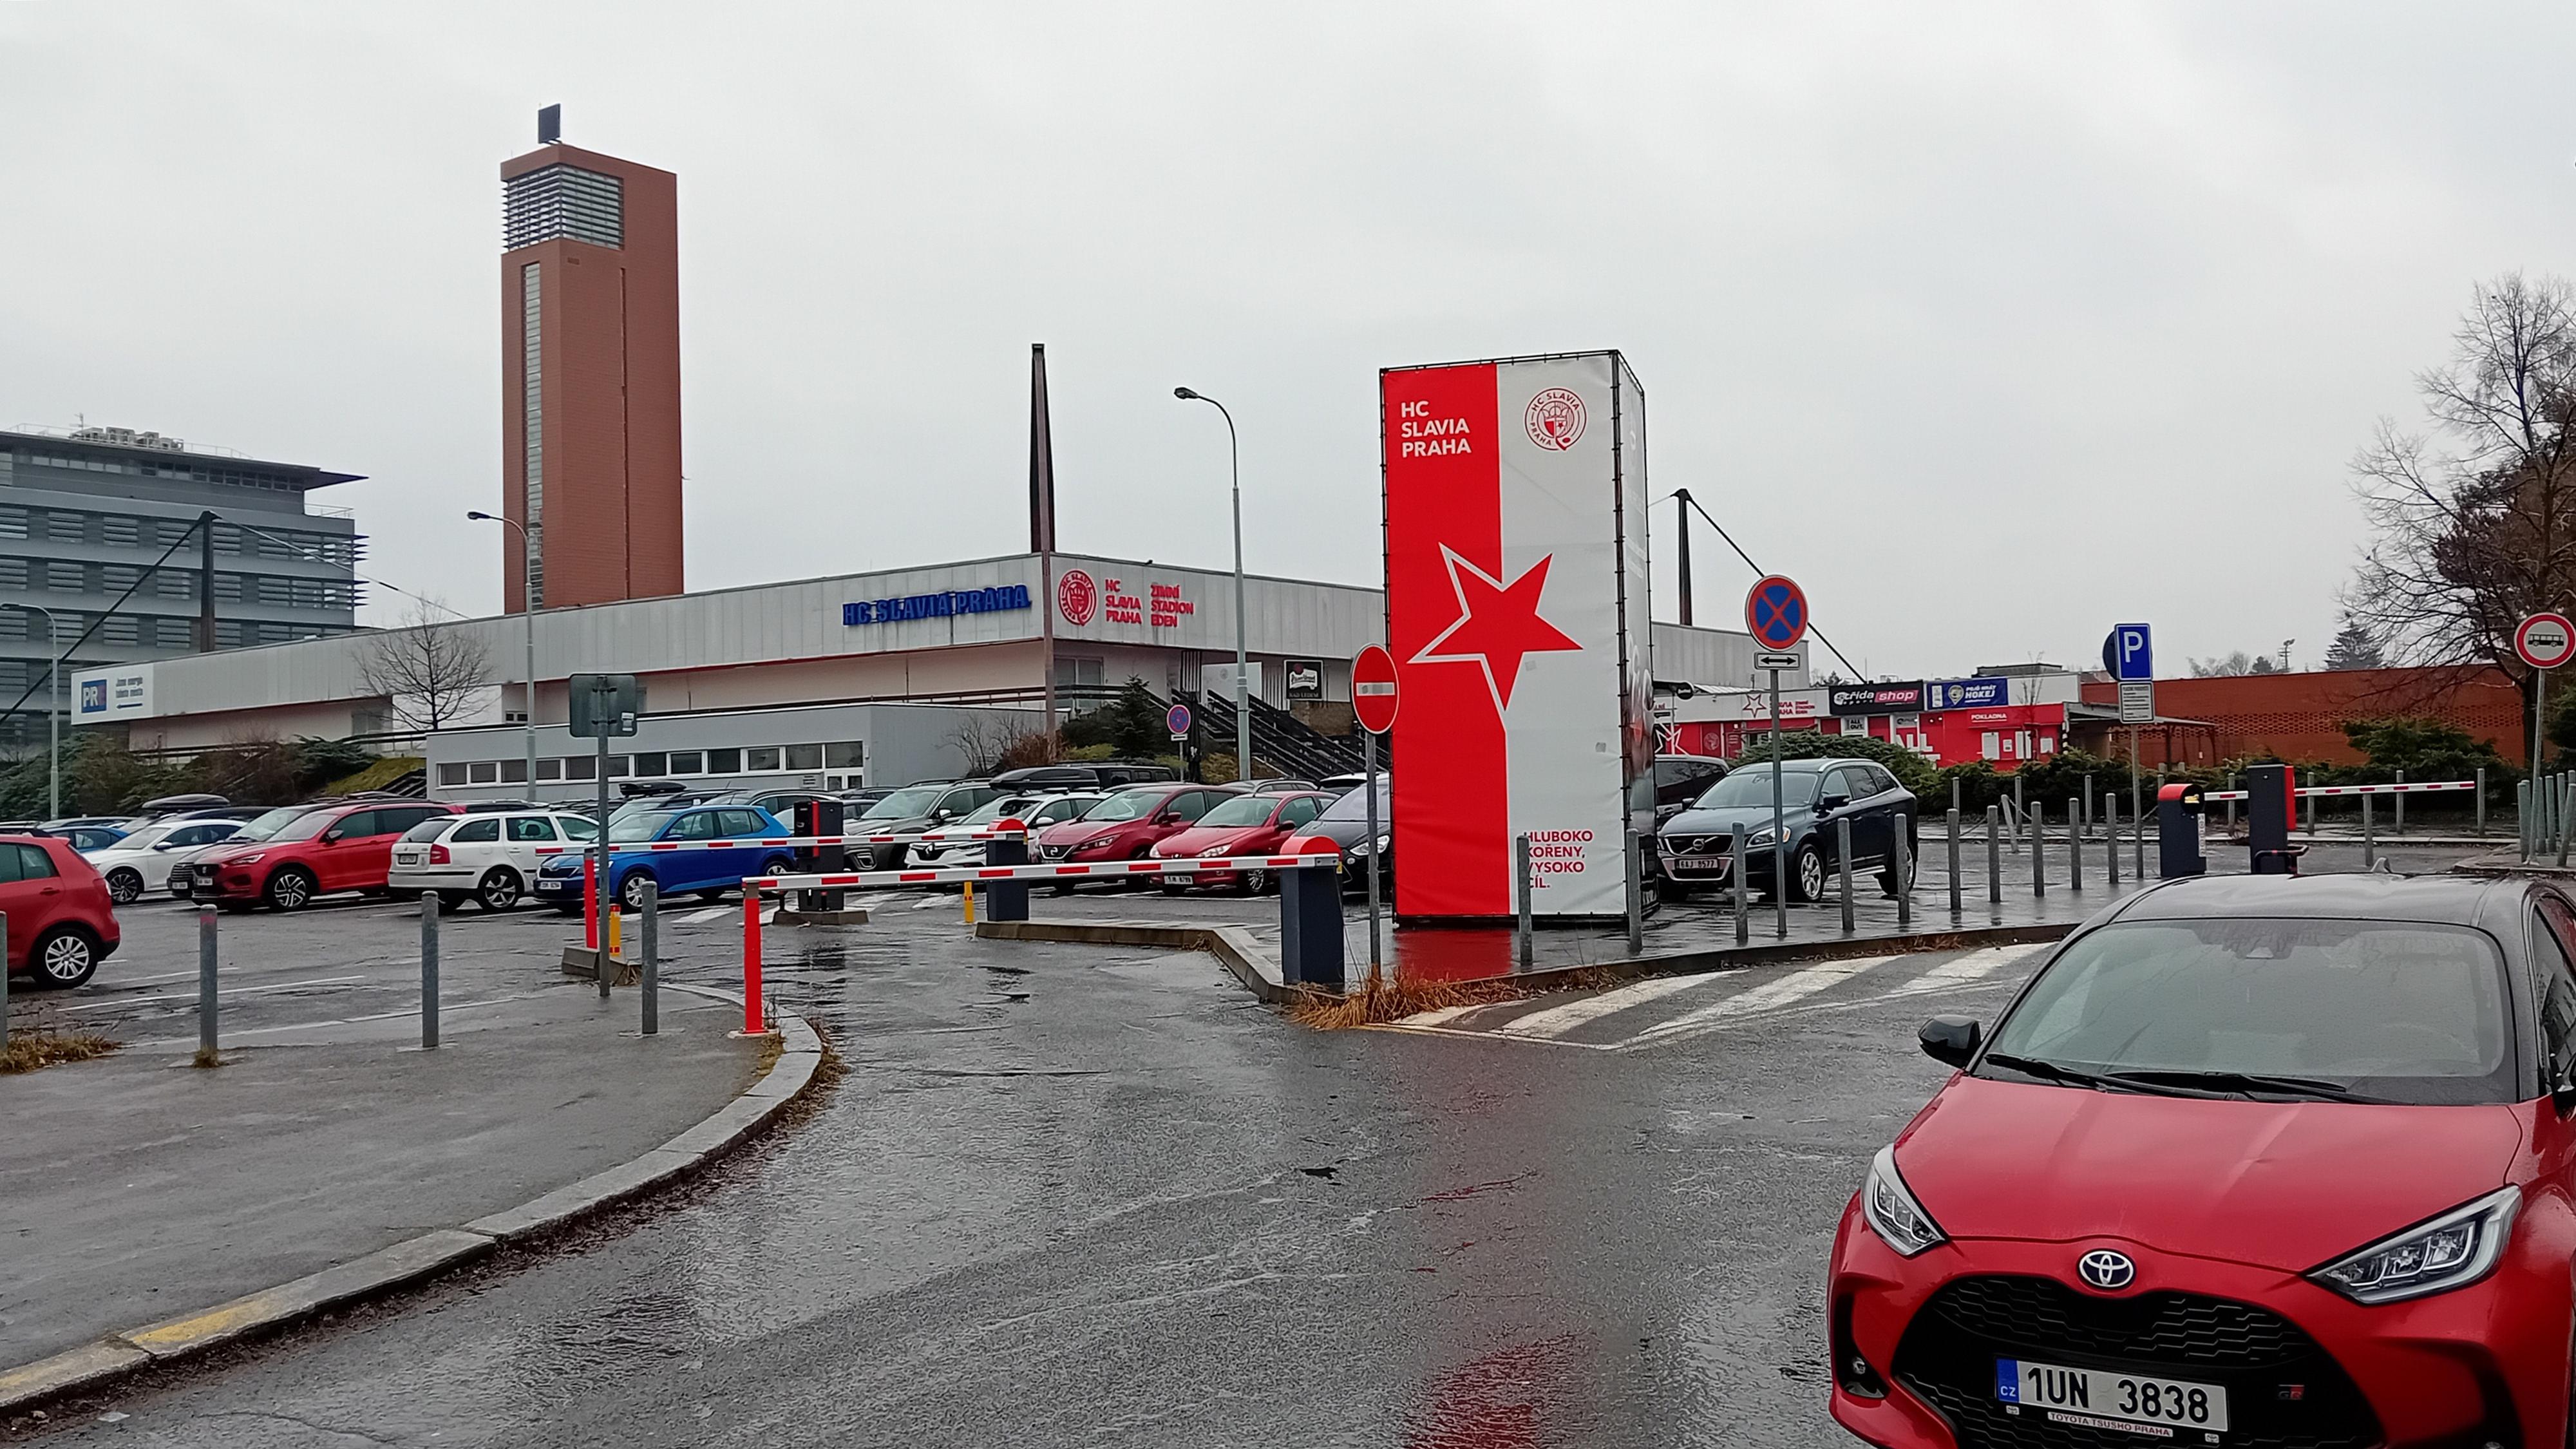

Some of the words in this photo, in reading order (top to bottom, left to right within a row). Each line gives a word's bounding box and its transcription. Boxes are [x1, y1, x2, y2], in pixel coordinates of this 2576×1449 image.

[1401, 401, 1430, 418] HC
[1531, 397, 1544, 412] HC
[1546, 392, 1580, 411] SLAVIA
[1401, 418, 1470, 438] SLAVIA
[1530, 422, 1551, 446] PRAHA
[1402, 438, 1472, 458] PRAHA
[1105, 579, 1121, 592] HC
[1151, 583, 1180, 599] ZIMNÍ
[843, 602, 871, 625] HC
[874, 591, 952, 623] SLAVIA
[954, 584, 1030, 615] PRAHA
[1106, 595, 1141, 610] SLAVIA
[1151, 600, 1194, 615] STADION
[1106, 610, 1142, 625] PRAHA
[1151, 614, 1178, 628] EDEN
[2123, 631, 2143, 663] P
[1879, 691, 1914, 701] shop
[1965, 690, 1995, 699] HOKEJ
[1971, 710, 2007, 720] POKLADNA
[1523, 831, 1593, 842] HLUBOKO
[2000, 1385, 2016, 1397] CZ
[2027, 1367, 2089, 1408] 1UN
[2117, 1379, 2209, 1423] 3838
[2050, 1413, 2089, 1425] TOYOTA
[2093, 1419, 2132, 1430] TSUSHO
[2135, 1425, 2170, 1436] PRAHA
